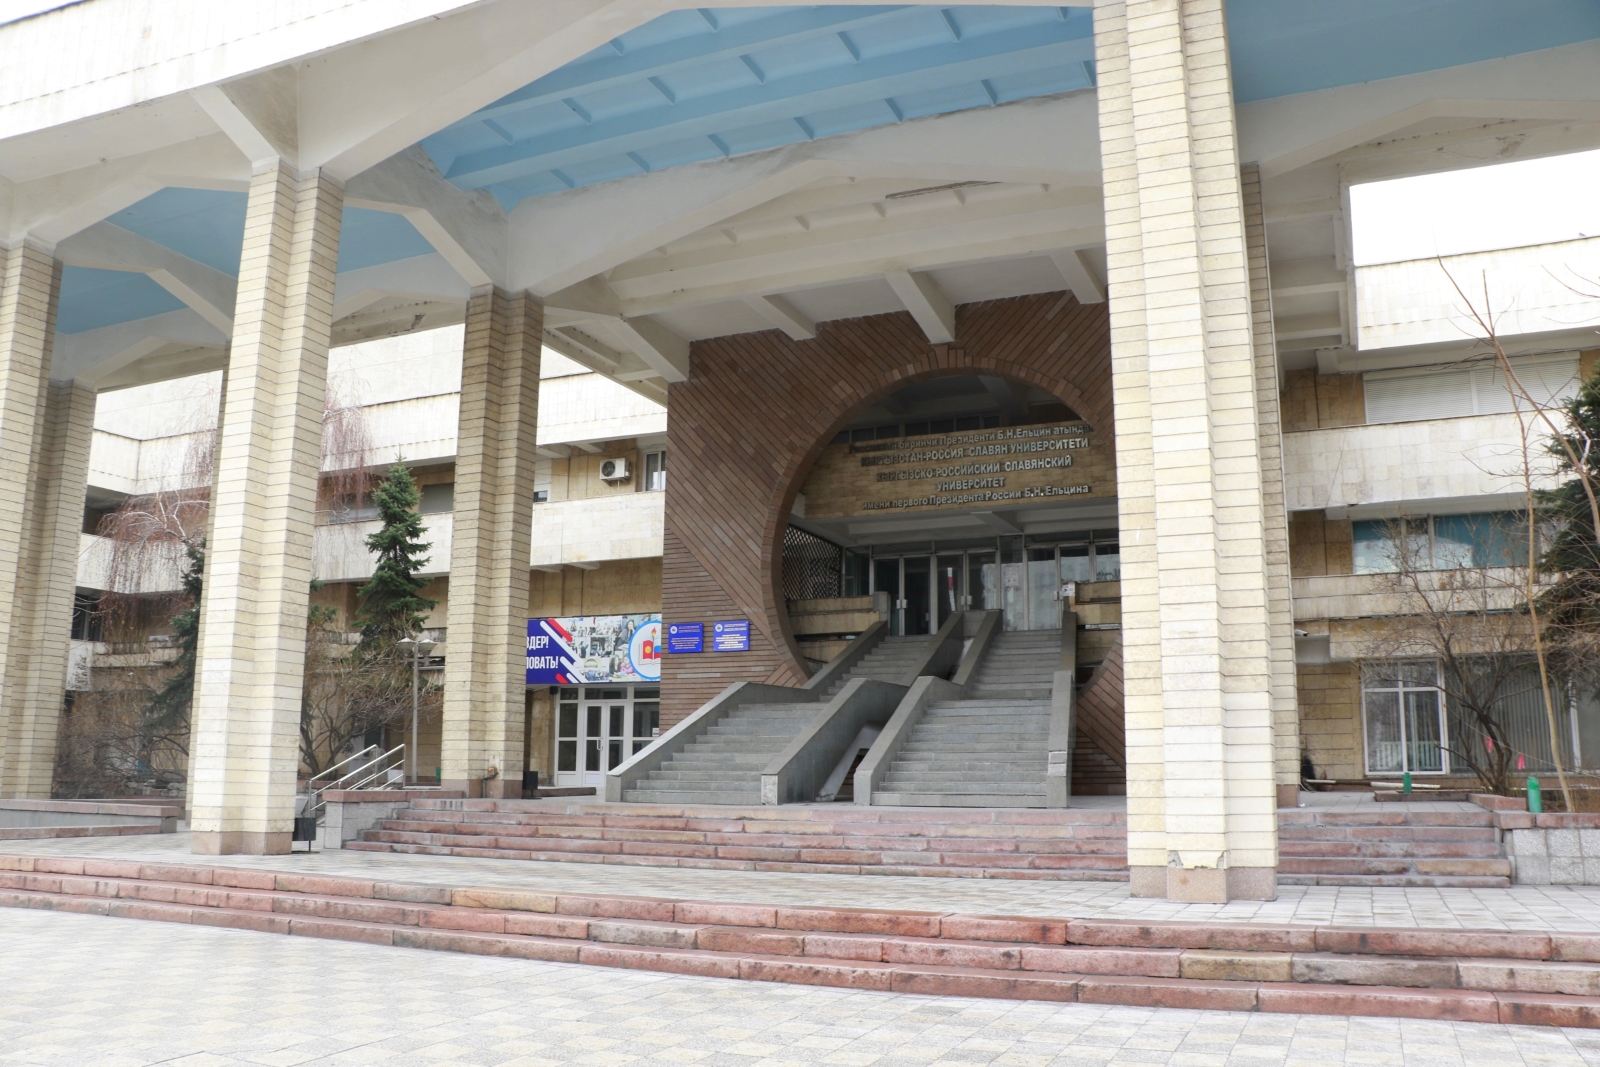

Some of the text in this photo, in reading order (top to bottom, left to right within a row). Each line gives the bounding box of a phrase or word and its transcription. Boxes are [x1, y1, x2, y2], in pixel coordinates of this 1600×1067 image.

[899, 439, 938, 450] биринчи
[940, 433, 995, 446] Президенти
[997, 428, 1051, 440] Б.Н.Ельцин
[861, 438, 1089, 467] КЫРГЫЗСТАН-РОССИЯ СЛАВЯН УНИВЕРСИТЕТИ
[1004, 454, 1072, 472] СЛАВЯНСКИЙ
[937, 477, 1005, 492] УНИВЕРСИТЕТ
[862, 485, 1089, 510] имени первого Президента России Б.Н. Ельцина
